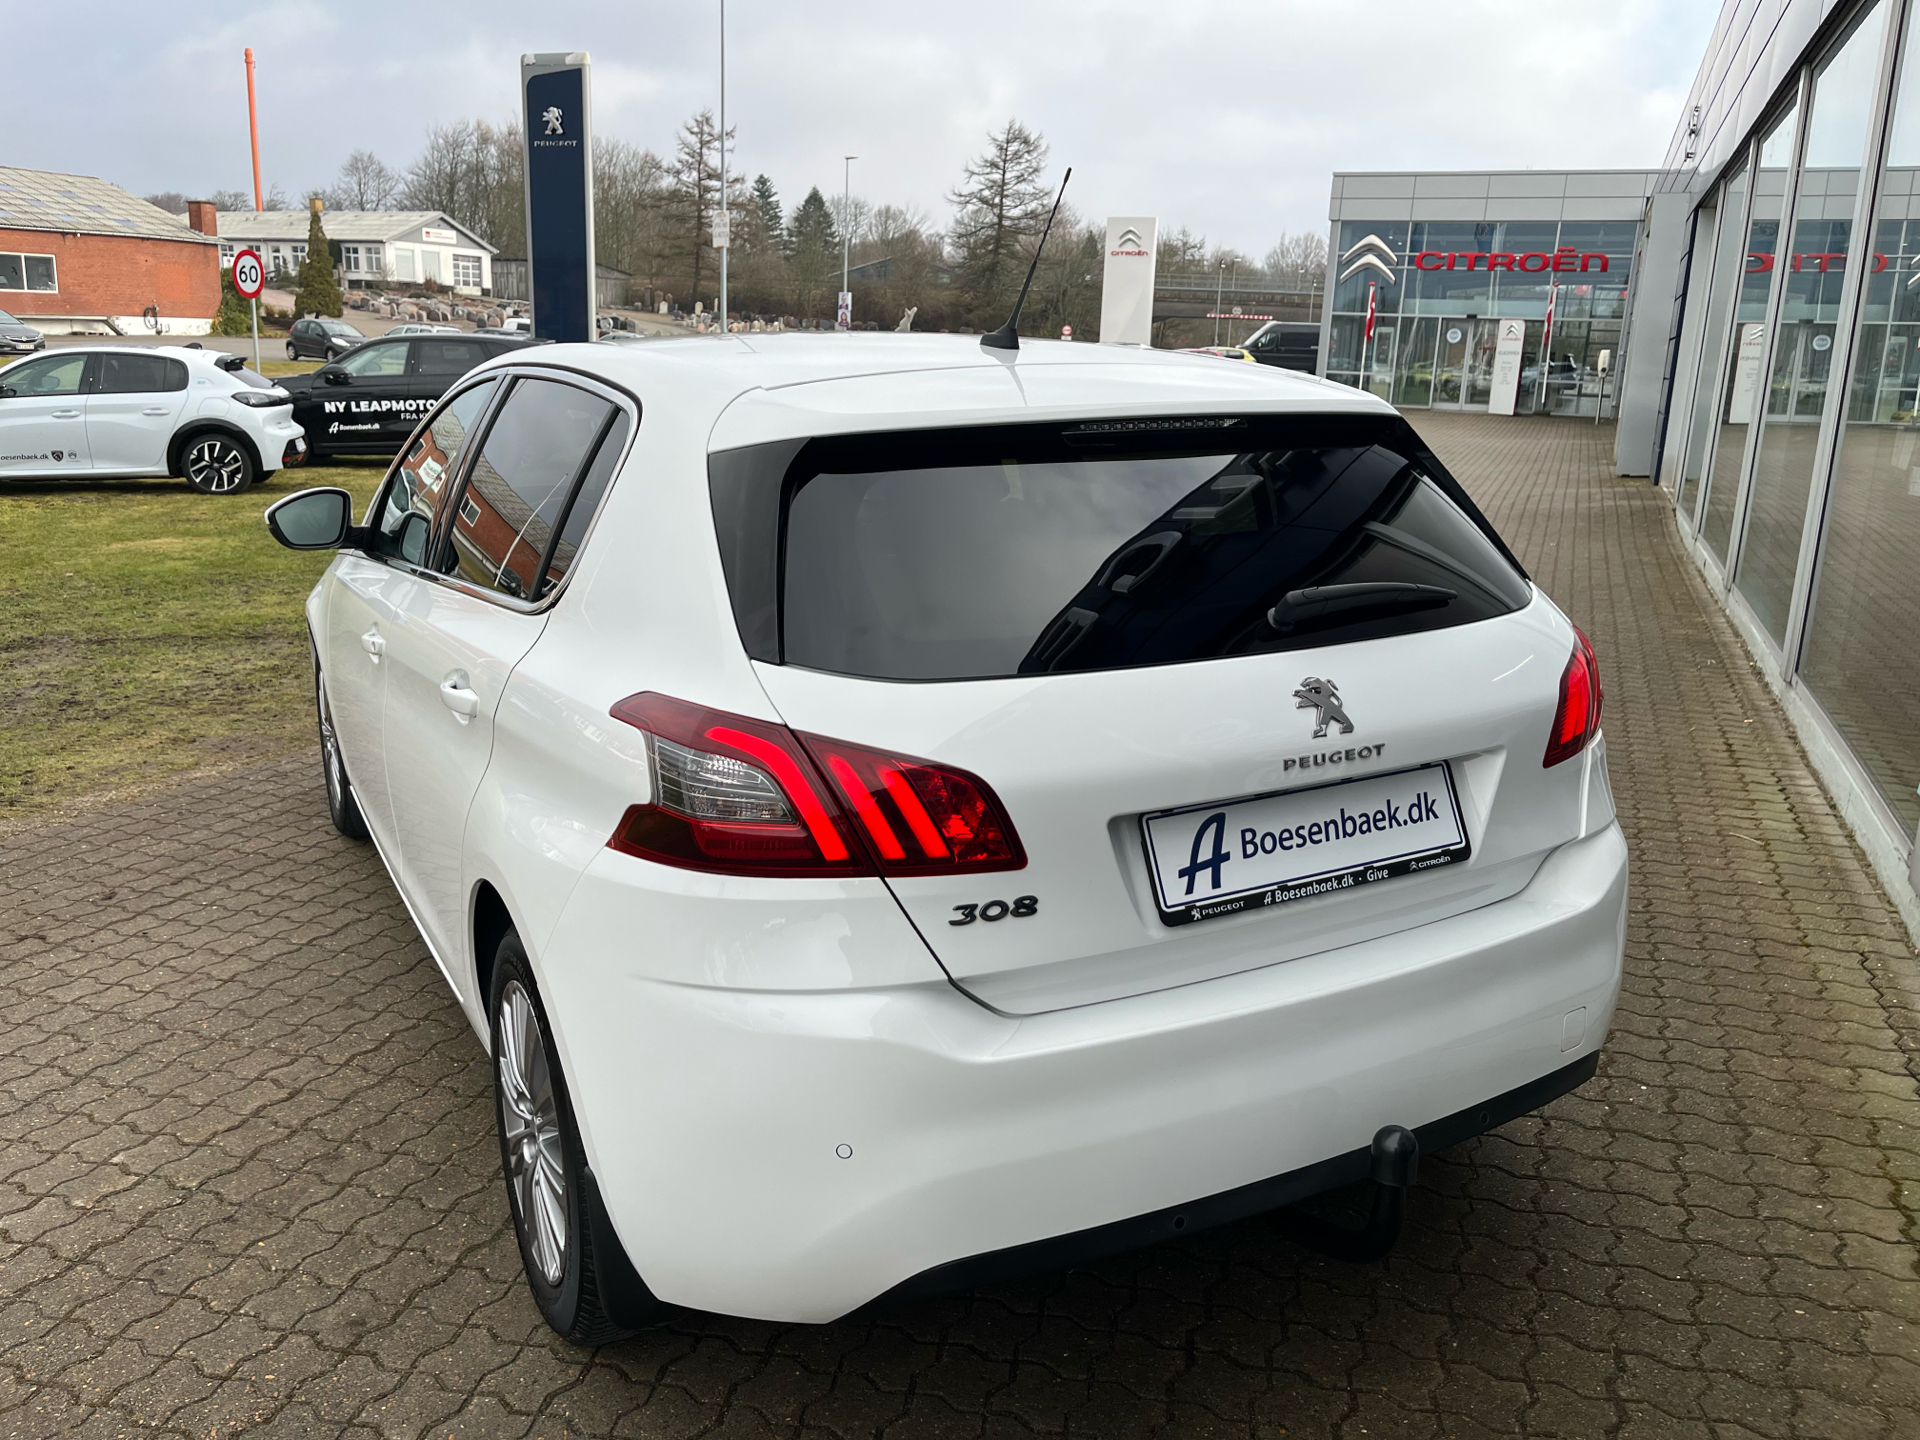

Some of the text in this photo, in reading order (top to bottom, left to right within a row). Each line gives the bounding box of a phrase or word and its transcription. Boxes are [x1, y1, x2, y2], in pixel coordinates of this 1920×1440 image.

[1414, 246, 1609, 272] CITROËN
[239, 265, 258, 283] 60
[324, 400, 438, 413] NY LEAPMOTO
[339, 423, 380, 431] Boesenbaek.dk
[1283, 743, 1385, 771] PEUGEOT
[1240, 791, 1439, 859] Boesenbaek.dk
[1418, 856, 1451, 868] CITROËN
[1275, 874, 1354, 902] Boesenbaek.dk
[1366, 869, 1389, 881] Give
[948, 895, 1038, 926] 308
[1202, 901, 1245, 915] PEUGEOT
